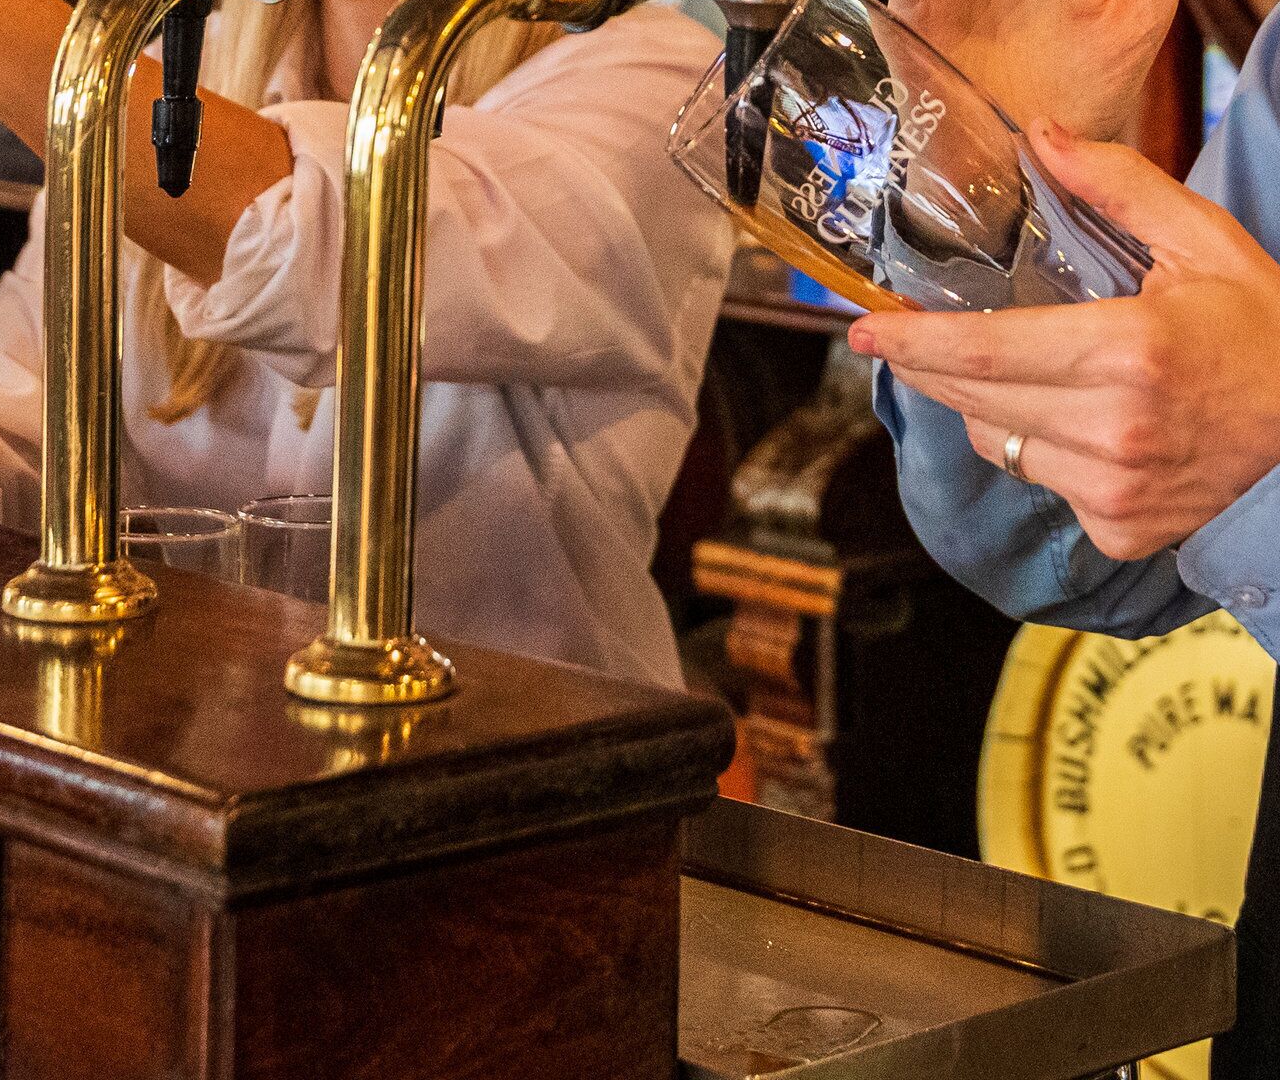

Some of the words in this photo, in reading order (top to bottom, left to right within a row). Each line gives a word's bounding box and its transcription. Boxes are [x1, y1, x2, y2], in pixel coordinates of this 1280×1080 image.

[816, 89, 947, 245] GUINNESS
[1055, 633, 1170, 816] BUSHMIL
[1126, 678, 1203, 770] PURE
[1209, 677, 1261, 726] MA
